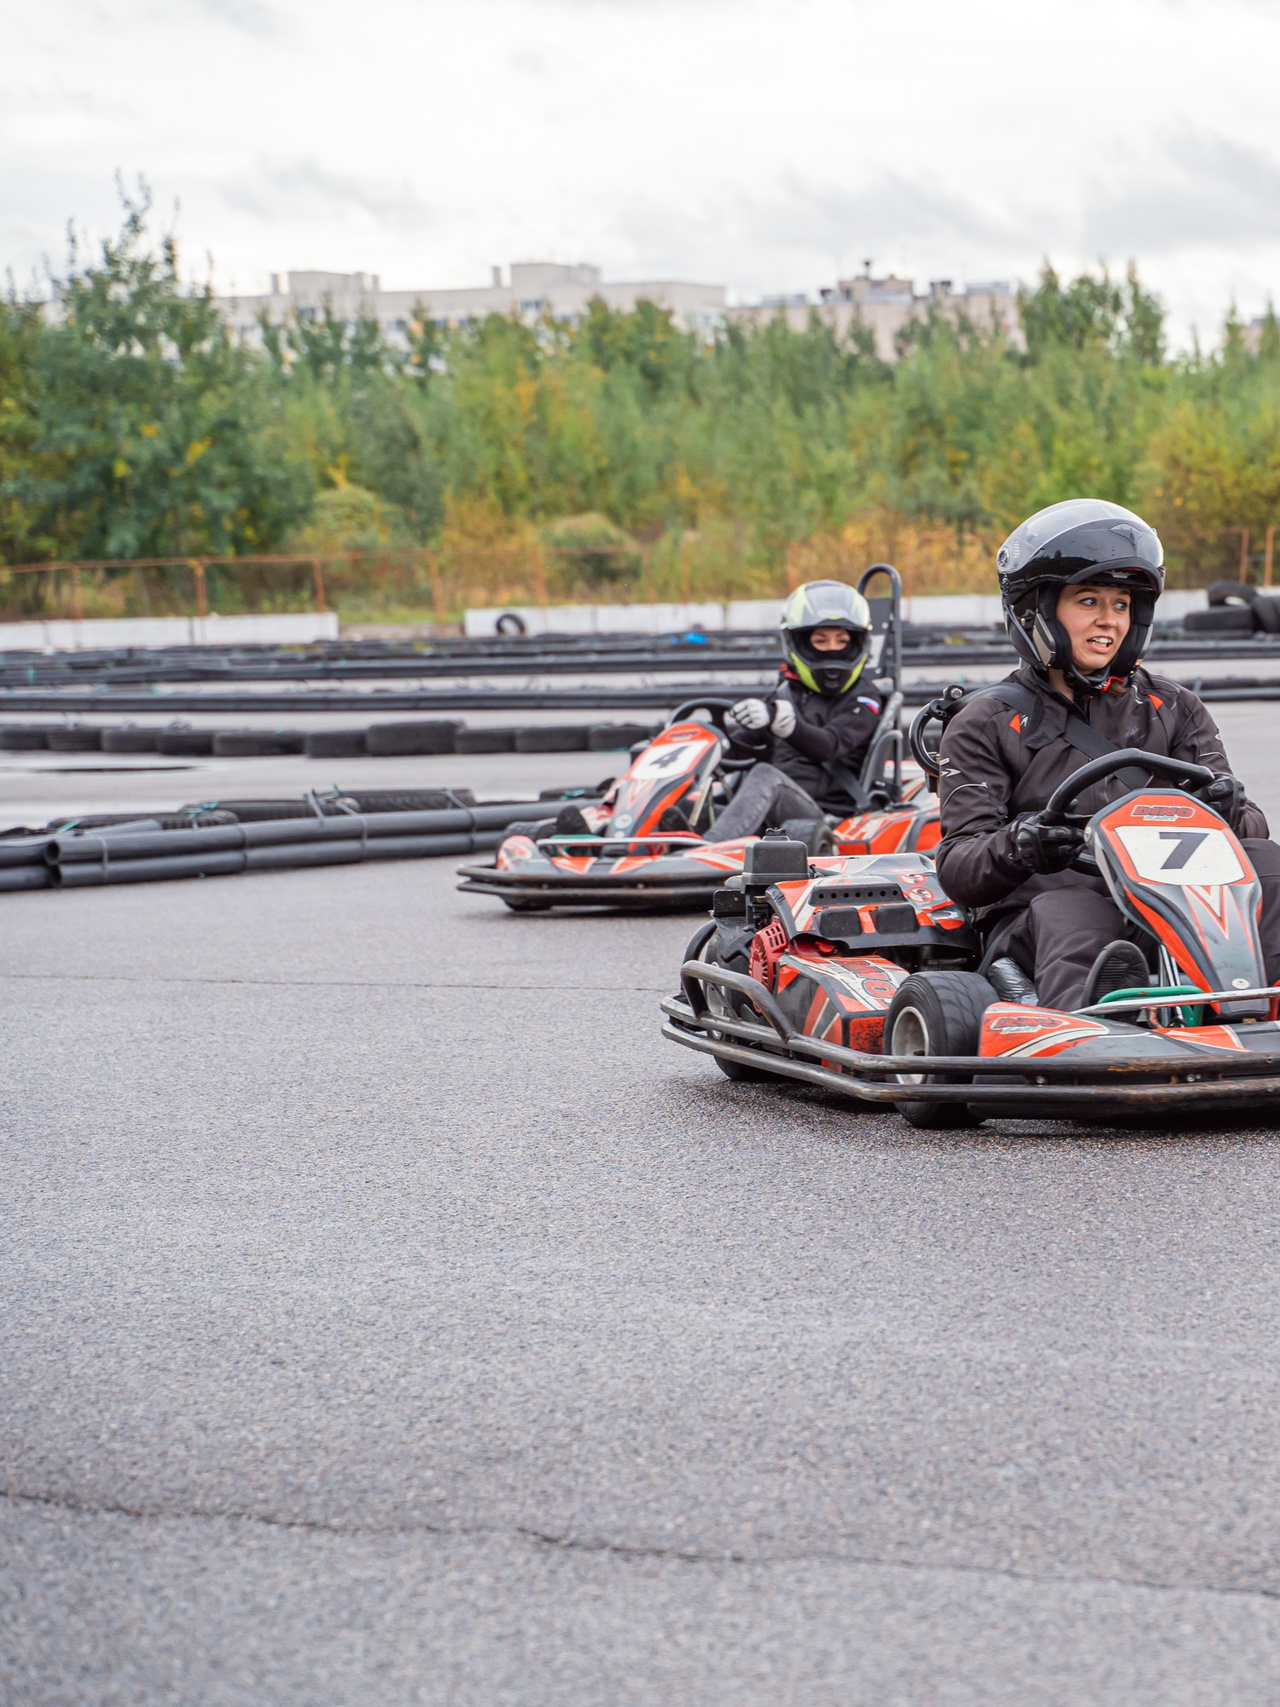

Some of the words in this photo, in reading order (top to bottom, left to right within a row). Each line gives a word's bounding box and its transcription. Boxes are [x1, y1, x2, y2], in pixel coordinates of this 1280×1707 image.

[648, 744, 691, 769] 4
[1131, 805, 1195, 818] DINO
[1158, 831, 1210, 870] 7
[993, 1016, 1064, 1028] DINO
